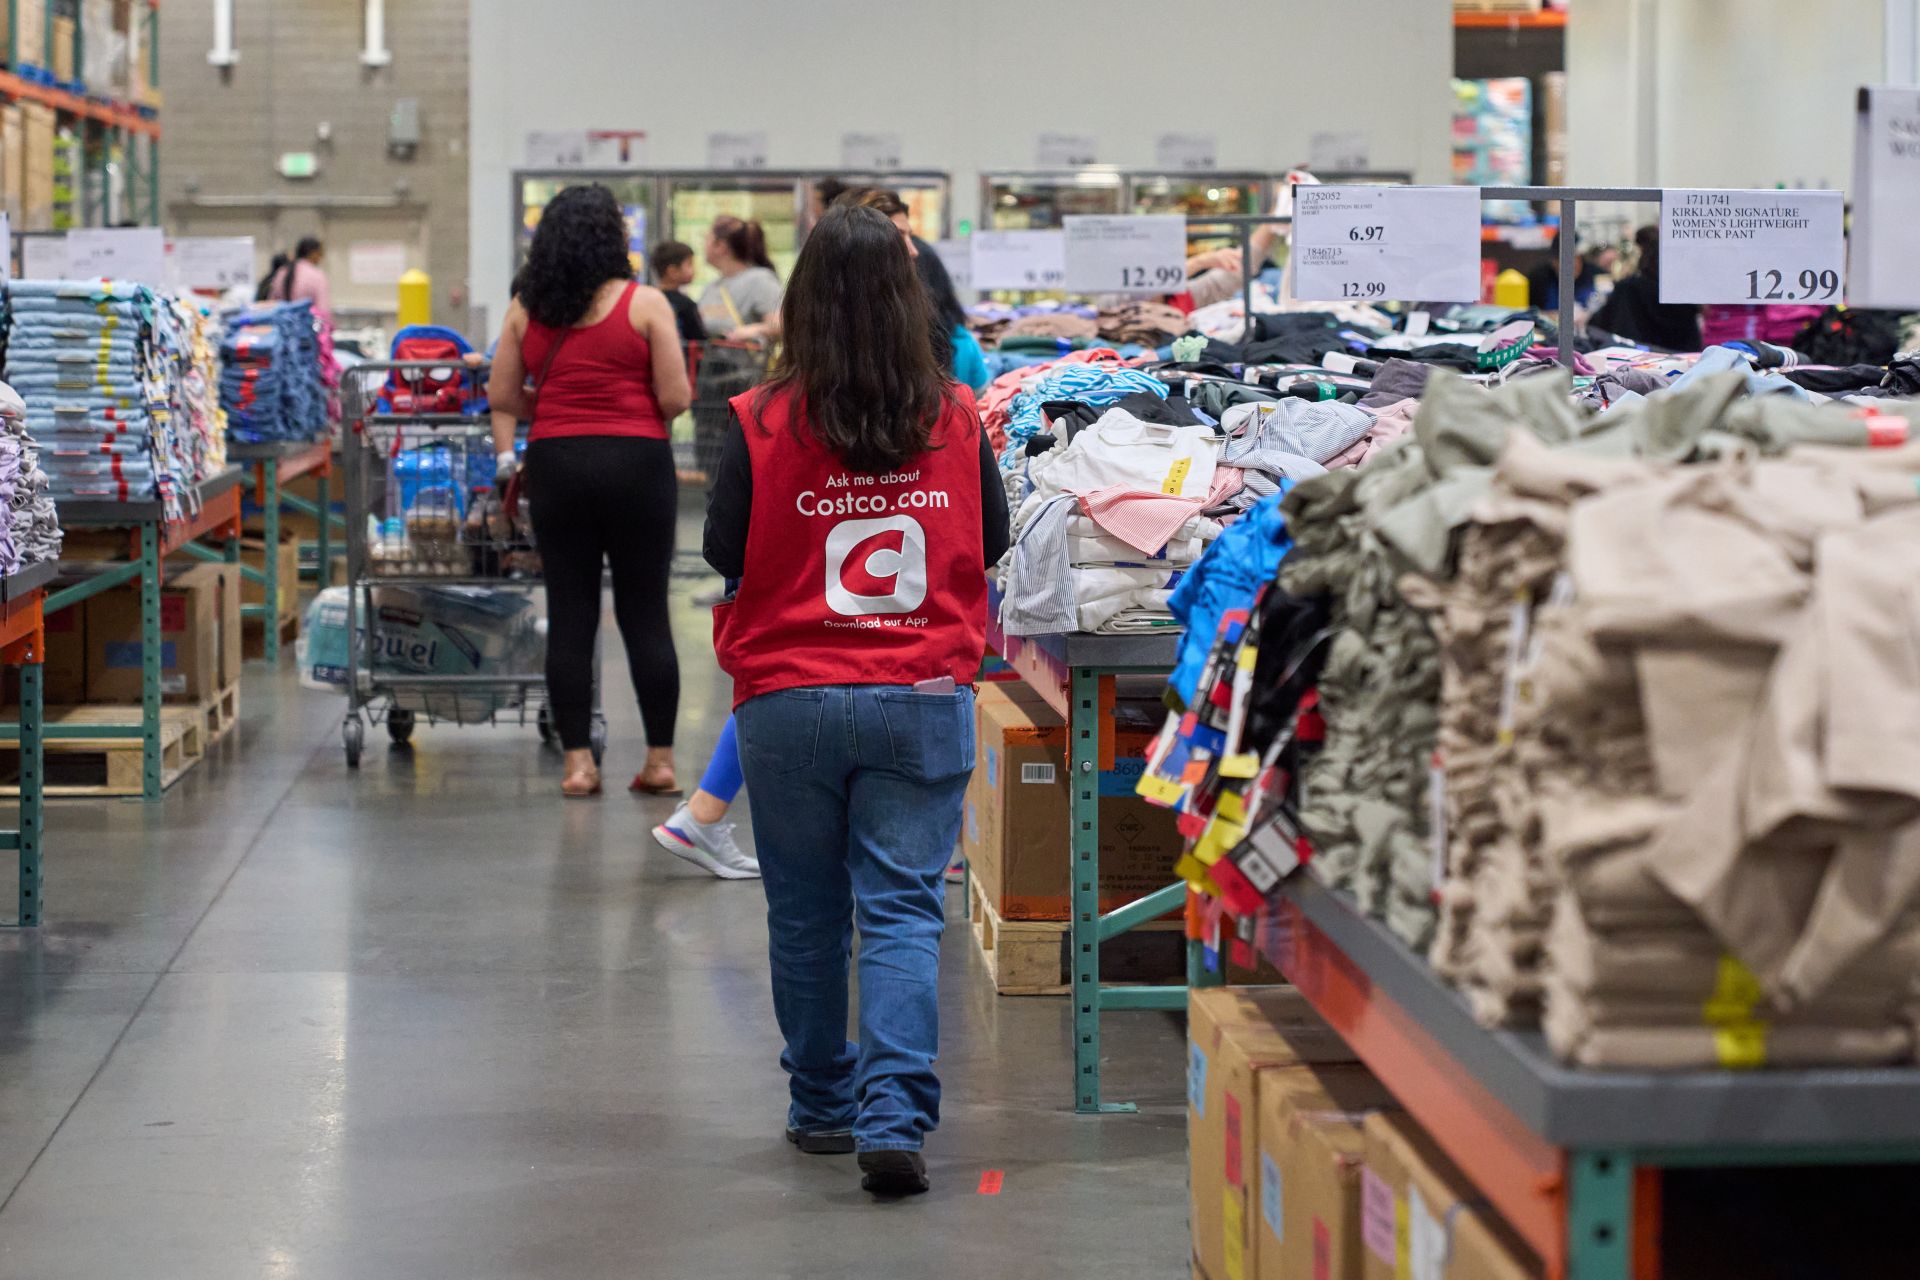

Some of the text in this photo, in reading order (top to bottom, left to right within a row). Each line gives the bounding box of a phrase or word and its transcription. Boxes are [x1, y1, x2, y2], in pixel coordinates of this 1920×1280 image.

[1306, 192, 1341, 200] 1752052
[1686, 195, 1730, 205] 1711741
[1672, 208, 1799, 217] KIRKLAND SIGNATURE
[1672, 219, 1810, 228] WOMEN'S LIGHTWEIGHT
[1349, 226, 1384, 241] 6.97
[1672, 230, 1756, 239] PINTUCK PANT
[1307, 248, 1342, 256] 1846713
[1121, 267, 1183, 288] 12.99
[1342, 282, 1386, 298] 12.99
[1746, 269, 1839, 300] 12.99
[826, 470, 920, 488] Ask me about
[796, 490, 949, 516] Costco.com
[824, 617, 929, 629] Download our App
